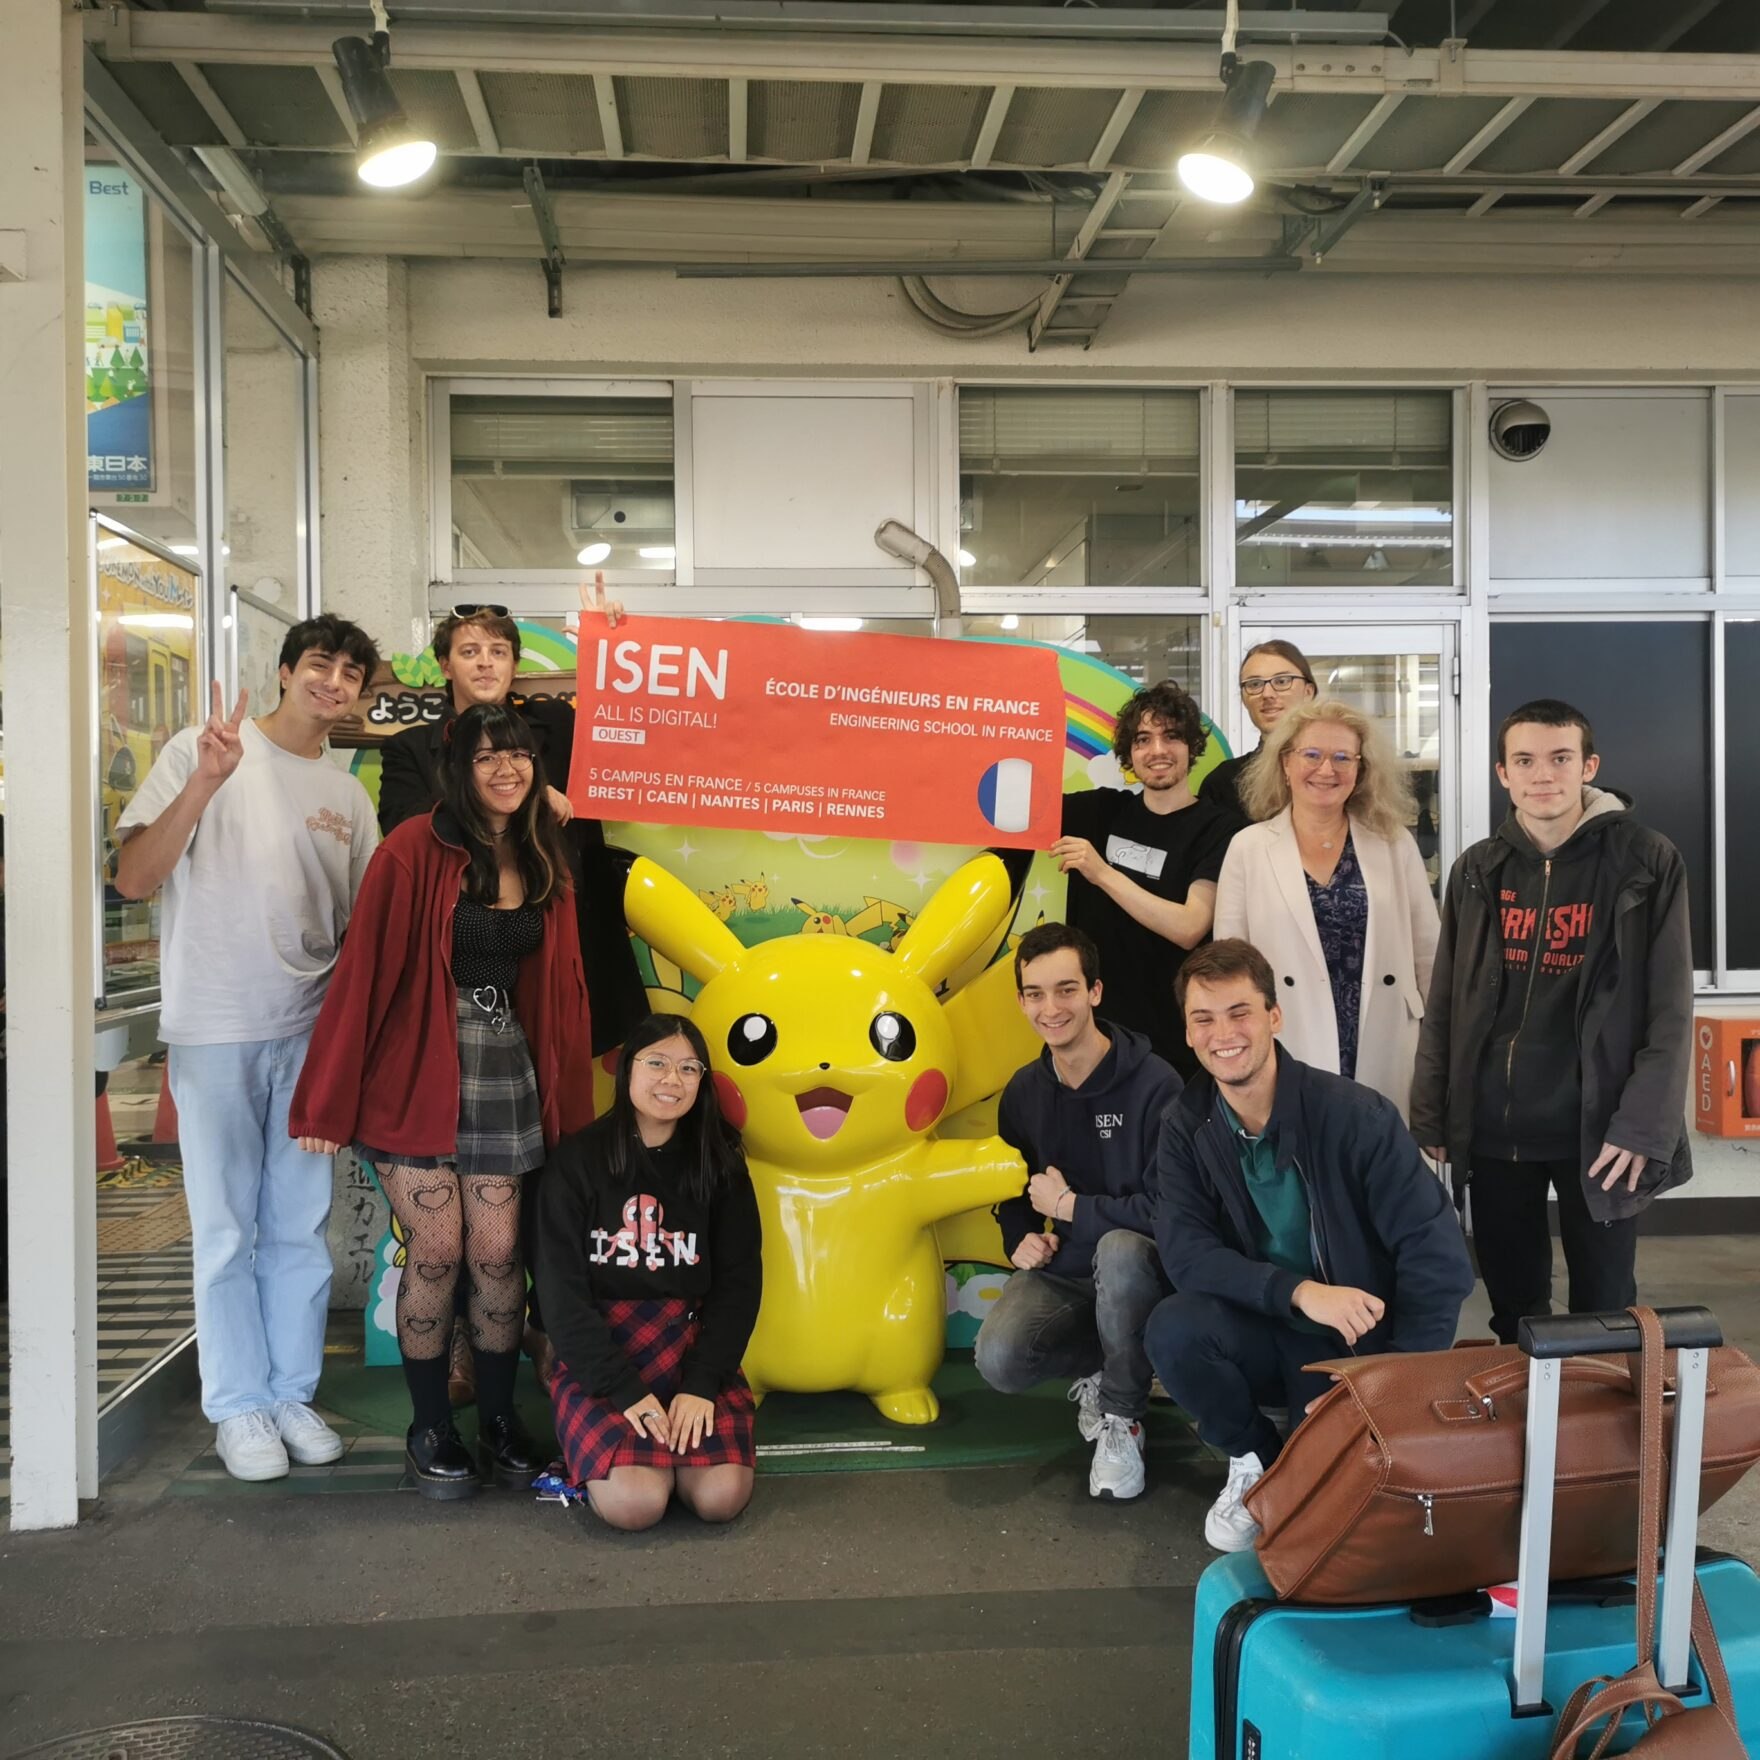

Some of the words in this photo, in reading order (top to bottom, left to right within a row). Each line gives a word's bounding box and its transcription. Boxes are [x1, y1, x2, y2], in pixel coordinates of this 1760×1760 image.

[89, 180, 129, 196] Best
[595, 638, 729, 701] ISEN
[765, 677, 819, 699] ÉCOLE
[824, 685, 941, 708] D'INGÉNIEURS
[945, 695, 968, 711] EN
[973, 698, 1040, 716] FRANCE
[594, 704, 625, 722] ALL
[629, 706, 644, 723] IS
[648, 708, 717, 729] DIGITAL!
[829, 712, 921, 732] ENGINEERING
[923, 720, 978, 737] SCHOOL
[981, 725, 996, 738] IN
[999, 726, 1054, 743] FRANCE
[598, 728, 641, 743] OUEST
[589, 767, 598, 781] 5
[602, 768, 662, 786] CAMPUS
[665, 773, 684, 787] EN
[687, 774, 743, 791] FRANCE
[754, 782, 761, 793] 5
[763, 783, 824, 798] CAMPUSES
[827, 786, 839, 799] IN
[841, 787, 886, 802] FRANCE
[588, 785, 635, 801] BREST
[646, 790, 688, 805] CAEN
[700, 794, 760, 810] NANTES
[772, 799, 814, 814] PARIS
[826, 803, 886, 819] RENNES
[1701, 1053, 1712, 1112] AED
[1095, 1113, 1124, 1128] ISEN
[1099, 1128, 1112, 1139] CSI
[589, 1229, 697, 1268] ISEN
